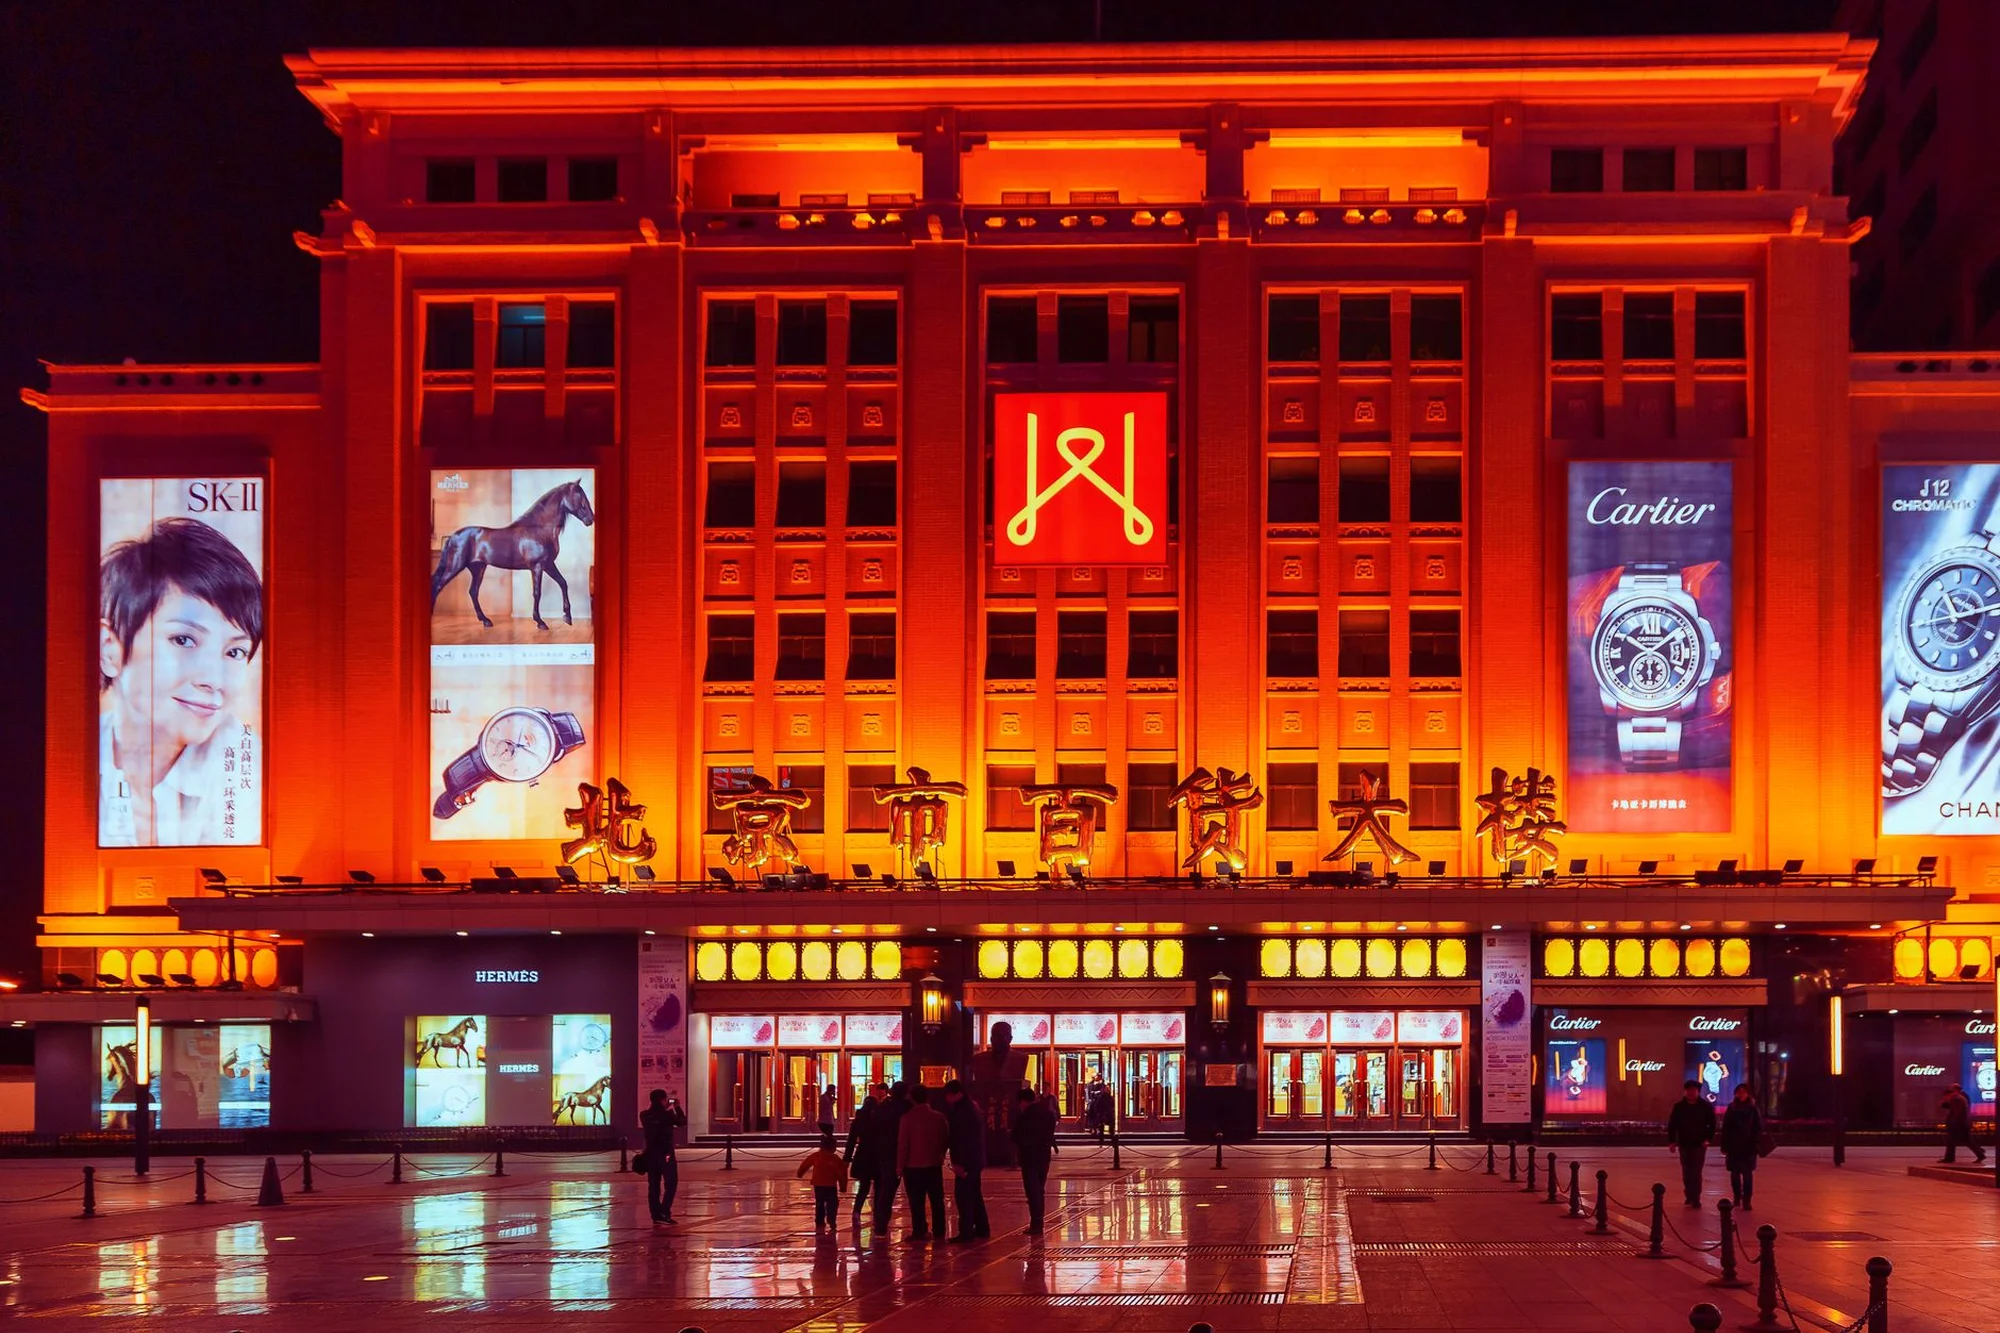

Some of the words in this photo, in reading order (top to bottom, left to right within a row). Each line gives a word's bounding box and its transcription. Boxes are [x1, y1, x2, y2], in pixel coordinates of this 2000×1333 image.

[1920, 479, 1950, 497] J12
[187, 482, 259, 513] SK-II
[1586, 486, 1716, 525] Cartier
[561, 766, 1568, 870] 北京市百货大楼
[1550, 1015, 1601, 1030] Cartier
[1689, 1015, 1741, 1030] Cartier
[1625, 1059, 1665, 1071] Cartier
[1904, 1063, 1945, 1076] Cartier
